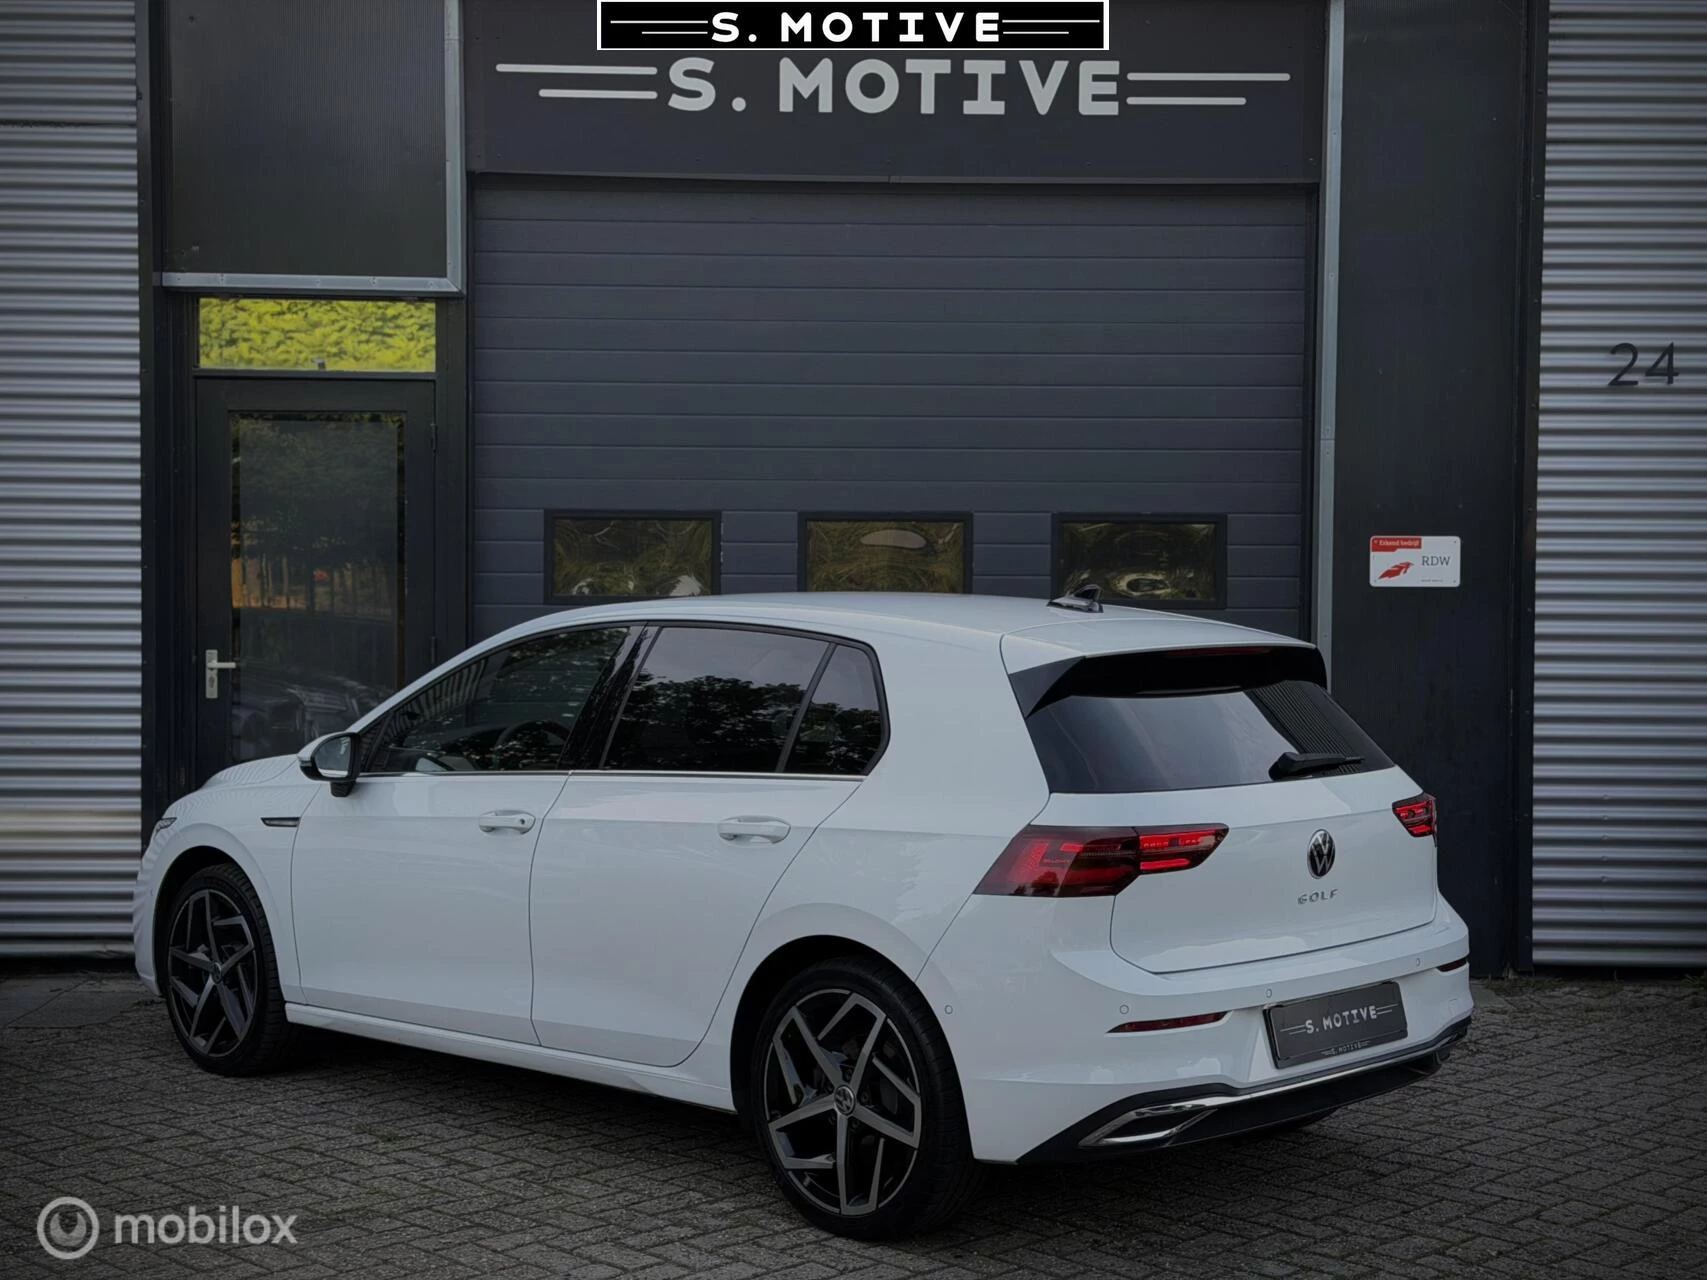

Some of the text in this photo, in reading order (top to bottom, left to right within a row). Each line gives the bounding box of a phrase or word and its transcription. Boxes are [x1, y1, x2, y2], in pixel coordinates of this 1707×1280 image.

[668, 57, 1119, 115] S. MOTIVE
[1608, 342, 1679, 386] 24
[1421, 555, 1451, 566] RDW
[1297, 888, 1338, 904] GOLF
[1305, 1006, 1378, 1034] S. MOTIVE
